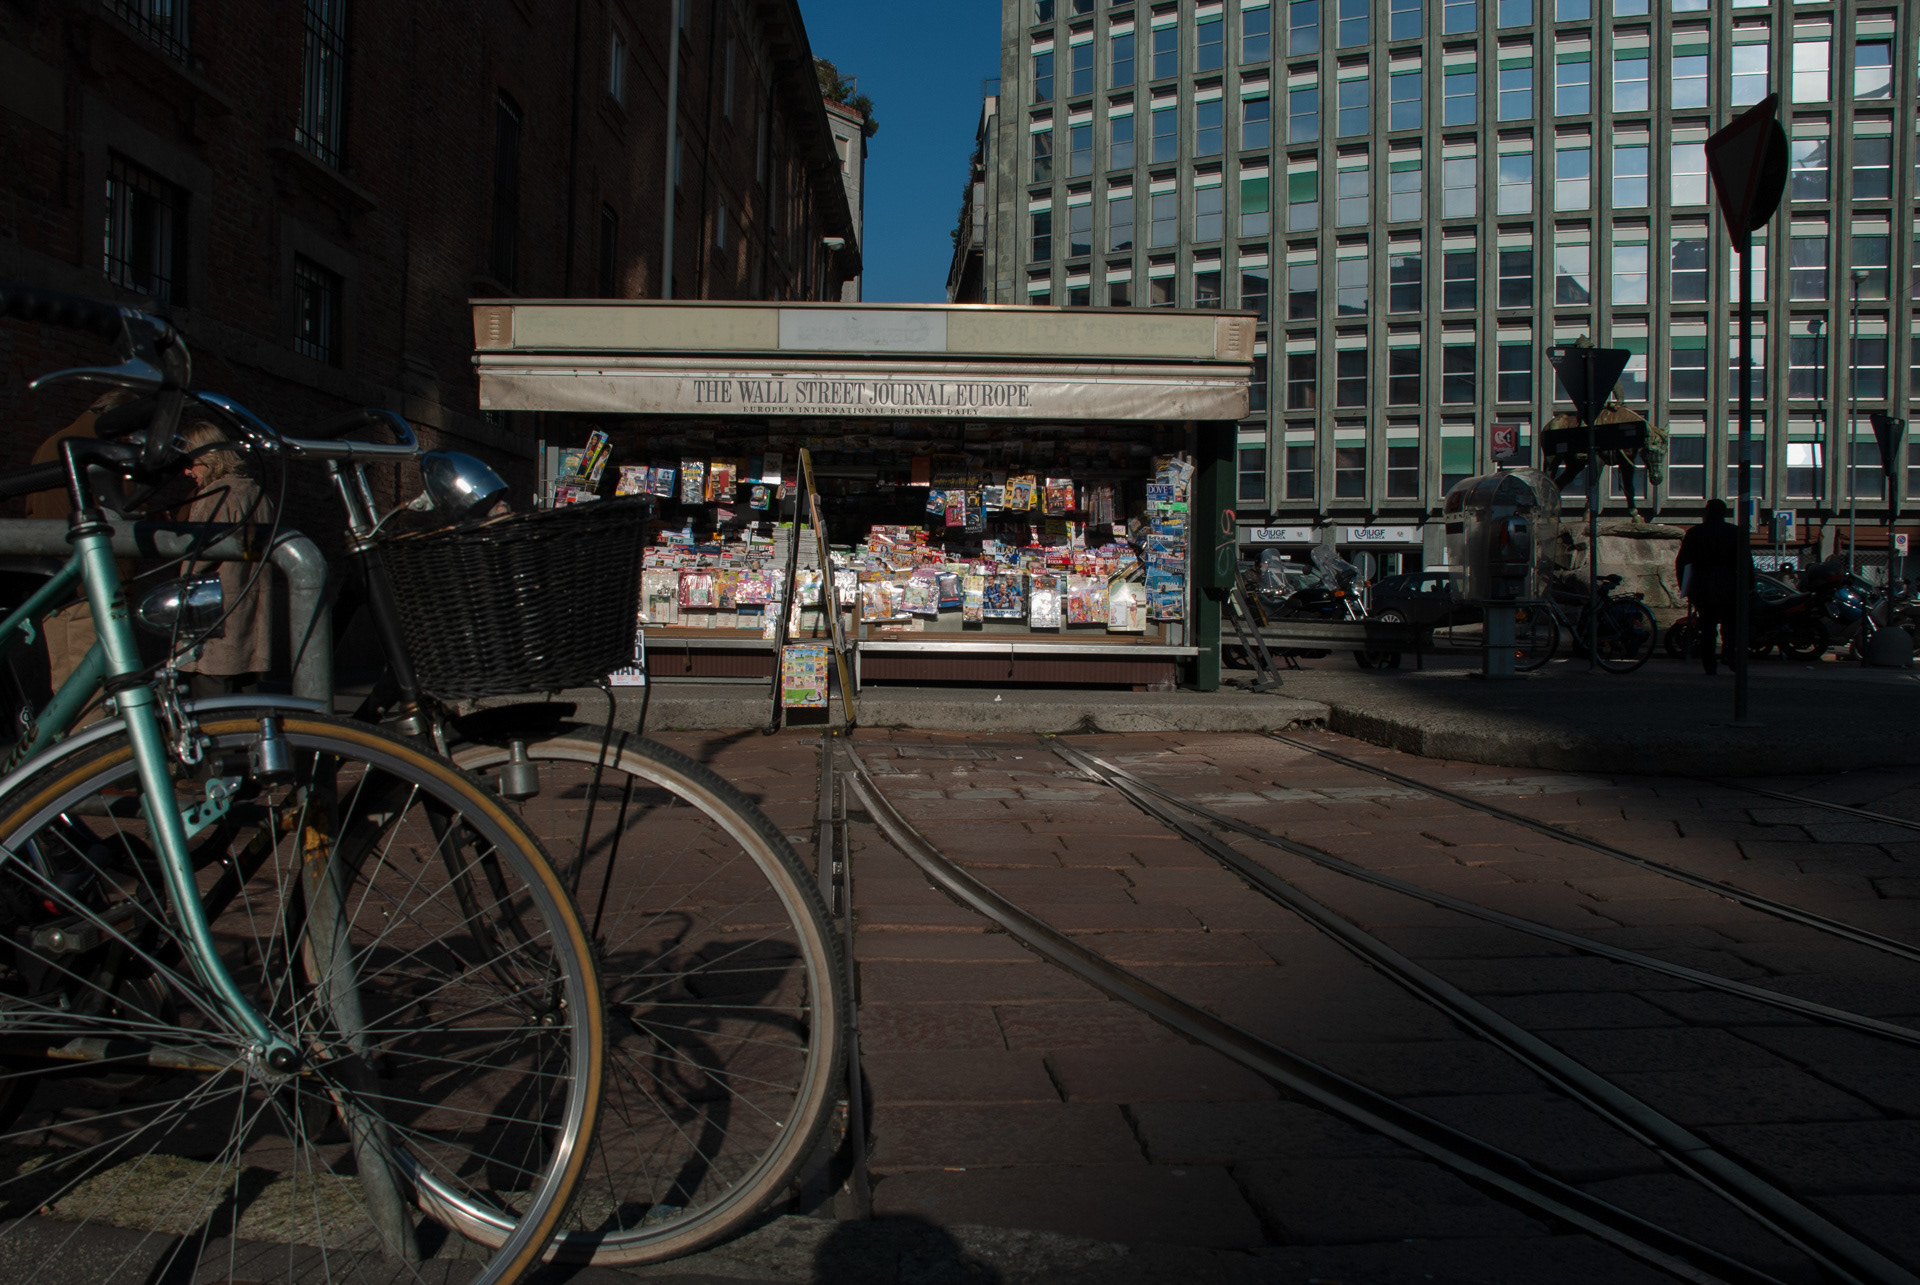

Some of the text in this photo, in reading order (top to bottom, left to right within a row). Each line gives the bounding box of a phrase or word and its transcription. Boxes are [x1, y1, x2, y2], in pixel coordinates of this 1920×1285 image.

[693, 380, 1032, 407] THE WALL STREET JOURNAL EUROPE.
[799, 407, 886, 415] INTERNATIONAL
[890, 408, 943, 416] BUSINESS
[1148, 485, 1169, 495] DOVE
